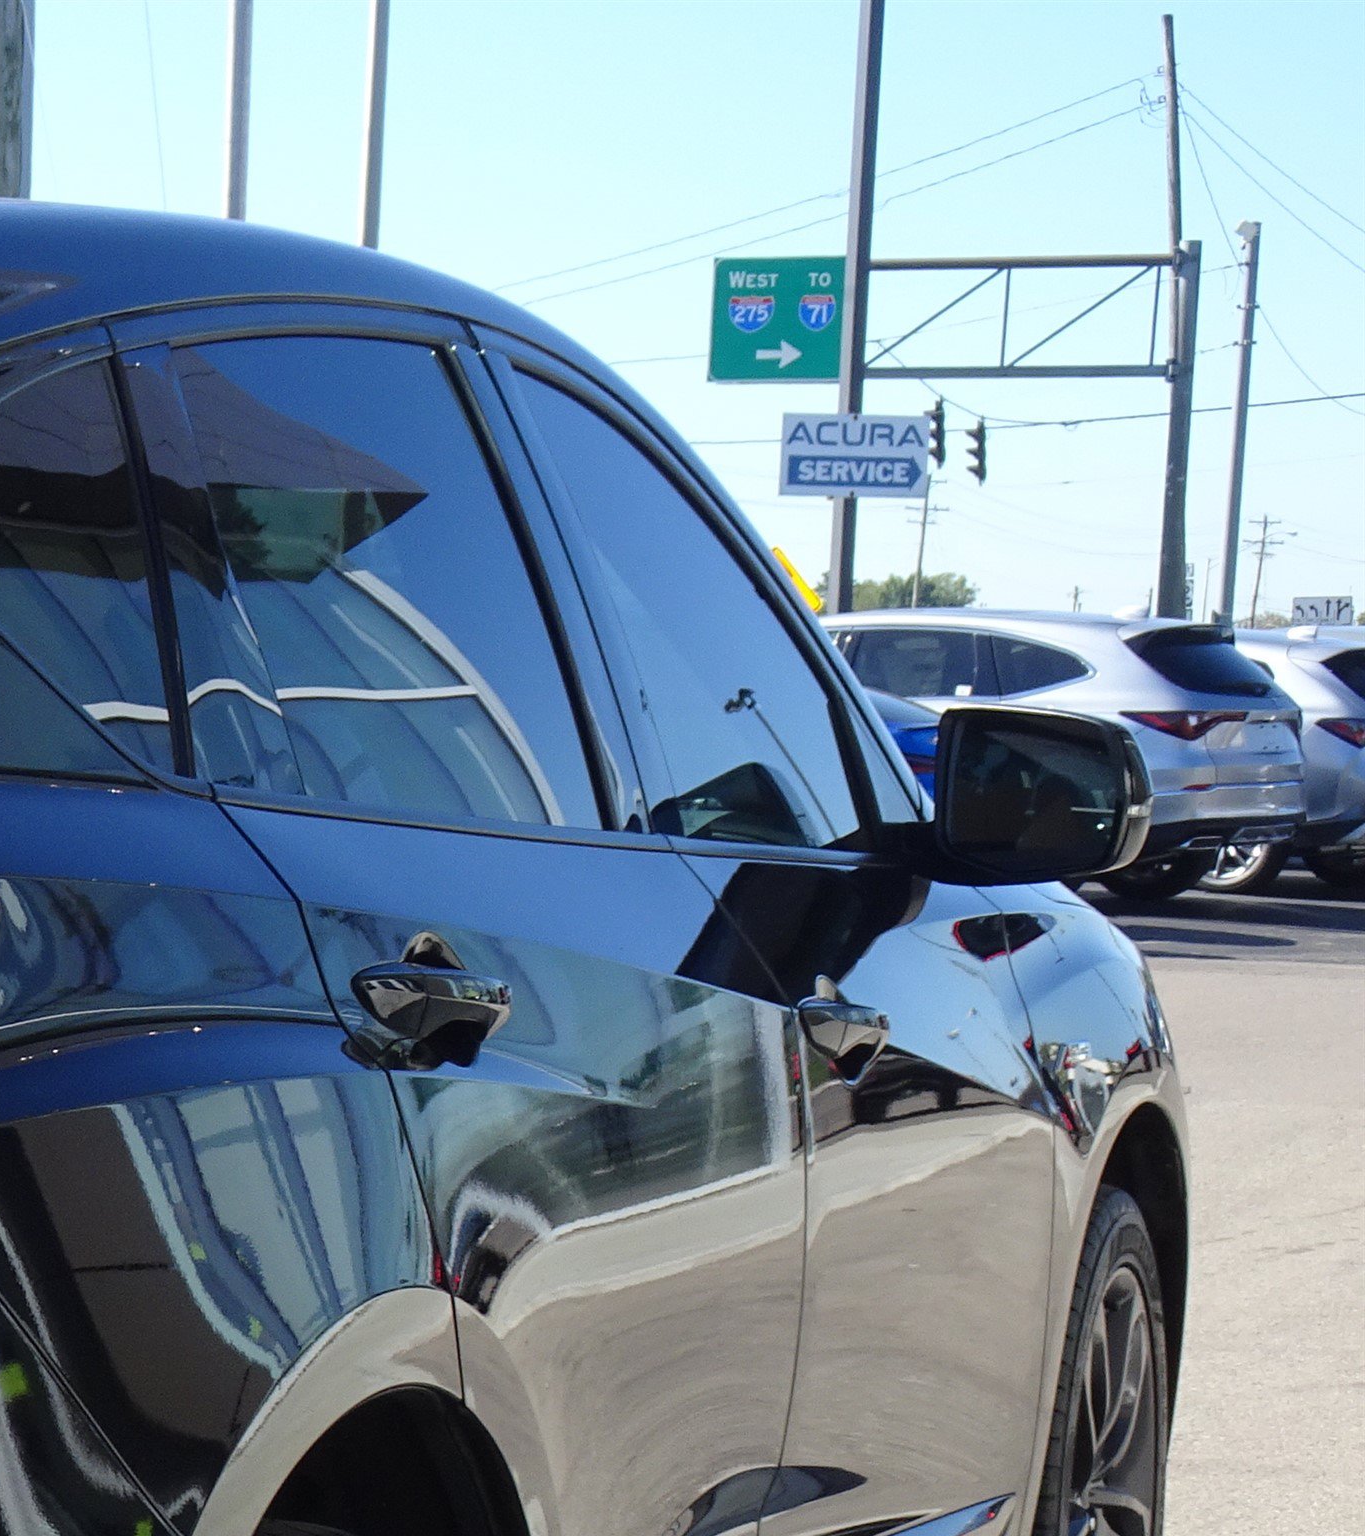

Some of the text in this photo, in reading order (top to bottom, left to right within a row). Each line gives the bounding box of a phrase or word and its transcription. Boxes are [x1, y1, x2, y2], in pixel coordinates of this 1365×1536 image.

[729, 270, 832, 288] WEST TO
[733, 304, 828, 323] 275 71
[787, 421, 924, 447] ACURA
[797, 459, 910, 483] SERVICE
